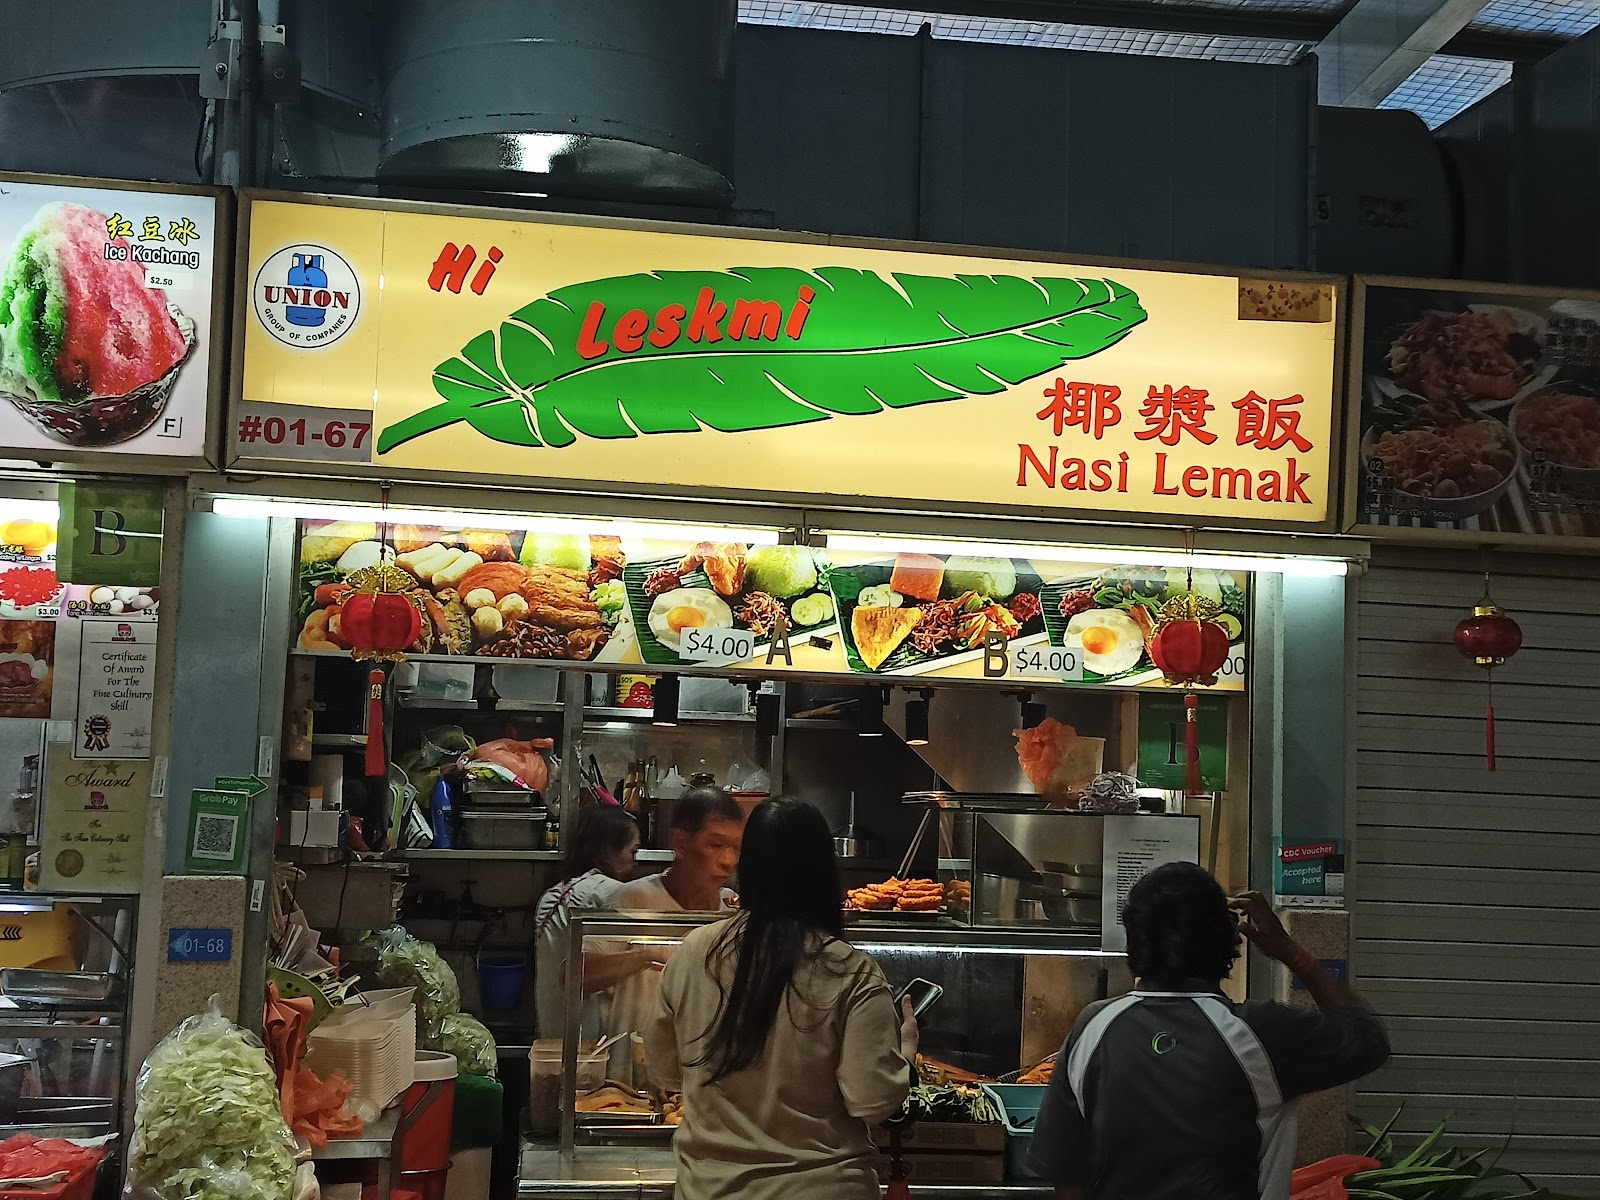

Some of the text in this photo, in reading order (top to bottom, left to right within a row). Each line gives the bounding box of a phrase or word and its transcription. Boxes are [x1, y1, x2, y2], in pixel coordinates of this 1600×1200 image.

[105, 212, 201, 246] 红豆冰
[104, 243, 200, 269] Ice Kachang
[427, 242, 504, 296] Hi
[150, 276, 173, 286] $2.50
[264, 285, 351, 309] UNION
[264, 308, 347, 342] GROUP OF COMPANIES
[576, 285, 816, 359] Leskmi
[163, 418, 175, 433] F
[238, 415, 371, 450] #01-67
[1016, 443, 1314, 504] Nasi Lemak
[1369, 460, 1382, 471] 02
[90, 508, 127, 557] B
[38, 608, 60, 616] $3.00
[686, 629, 750, 660] $4.00
[765, 617, 793, 667] A
[101, 650, 147, 663] Certificate
[984, 630, 1009, 678] B
[1014, 649, 1076, 674] $4.00
[103, 662, 115, 675] Of
[107, 675, 140, 687] For The
[93, 687, 152, 701] Fine Culinary
[65, 764, 136, 787] Award
[199, 793, 239, 806] GrabPay
[1283, 845, 1333, 858] CDC Voucher
[1282, 864, 1323, 878] Accepted
[1301, 875, 1323, 885] here
